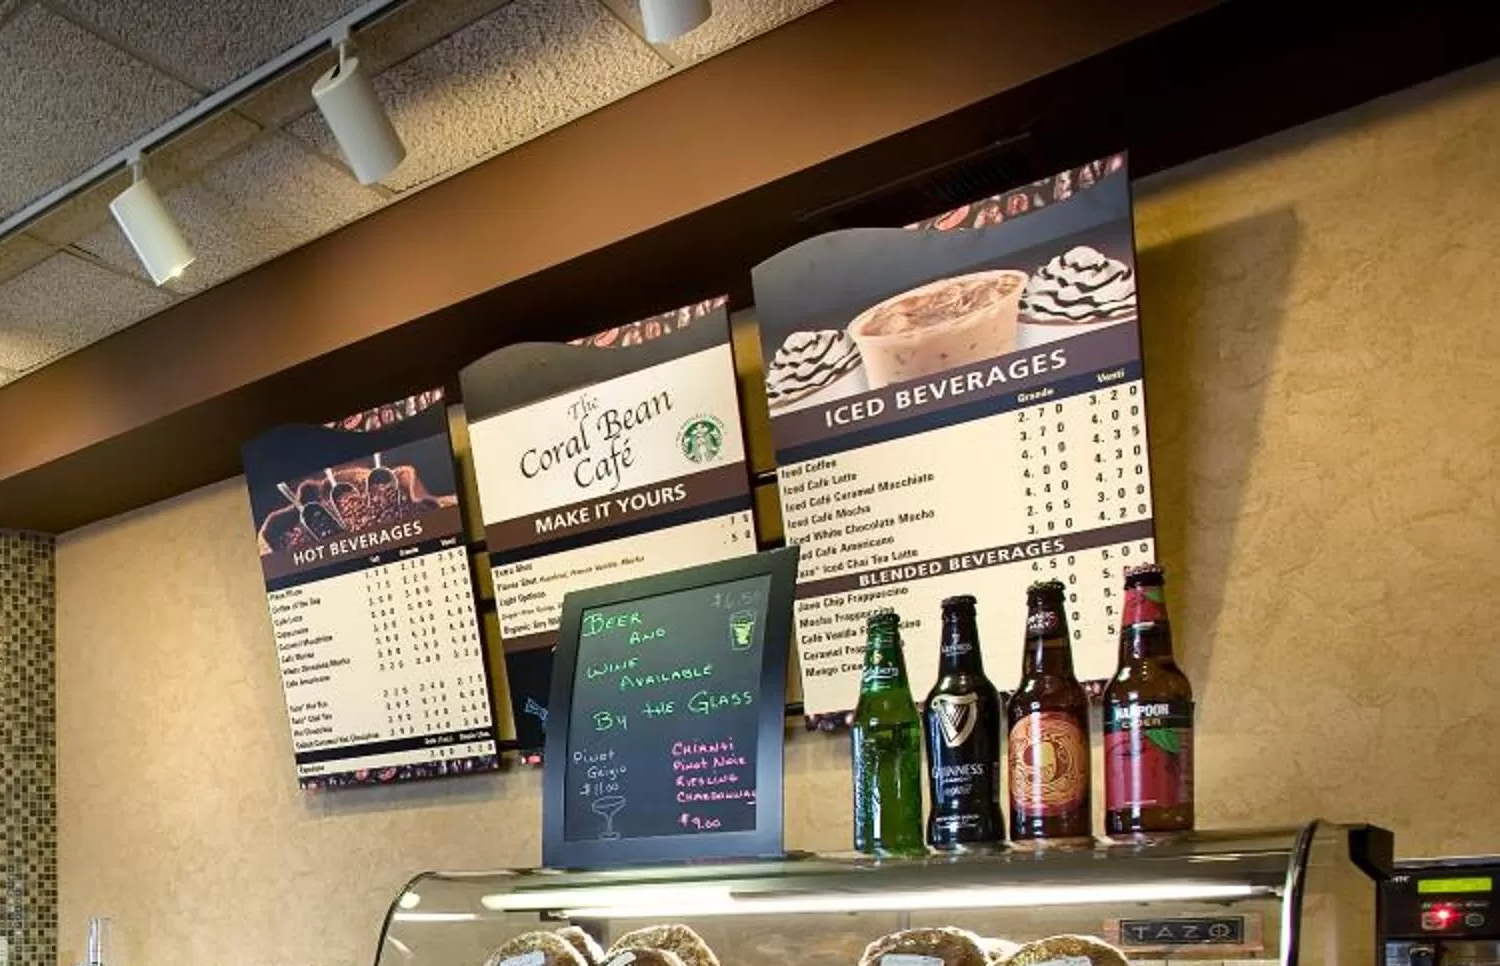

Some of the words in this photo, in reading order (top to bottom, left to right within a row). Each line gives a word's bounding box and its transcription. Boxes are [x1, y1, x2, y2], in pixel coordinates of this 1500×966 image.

[825, 398, 886, 428] ICED
[895, 349, 1068, 409] BEVERAGES
[1017, 387, 1055, 402] Grande
[1096, 368, 1125, 383] Venti
[568, 393, 598, 420] The
[520, 414, 591, 479] Coral
[597, 390, 675, 441] Bean
[574, 436, 635, 491] Café
[781, 467, 802, 479] Iced
[805, 459, 837, 473] Coffee
[784, 483, 805, 495] Iced
[832, 472, 857, 484] Latte
[785, 500, 807, 512] Iced
[833, 485, 875, 501] Caramel
[877, 472, 934, 491] Macchiato
[535, 502, 592, 535] MAKE
[595, 498, 613, 519] IT
[615, 483, 688, 513] YOURS
[788, 516, 809, 528] Iced
[836, 503, 871, 518] Mocha
[814, 528, 842, 541] White
[845, 517, 895, 535] Chocolate
[897, 508, 935, 523] Mocha
[294, 546, 325, 567] HOT
[332, 520, 424, 555] BEVERAGES
[840, 535, 895, 553] Americano
[847, 556, 869, 569] Chai
[871, 553, 889, 565] Tea
[891, 548, 919, 561] Latte
[858, 561, 942, 587] BLENDED
[949, 538, 1066, 571] BEVERAGES
[824, 596, 845, 608] Chip
[620, 664, 713, 691] AVAILABLE
[687, 690, 752, 716] GLASS
[1131, 923, 1231, 942] TAZO
